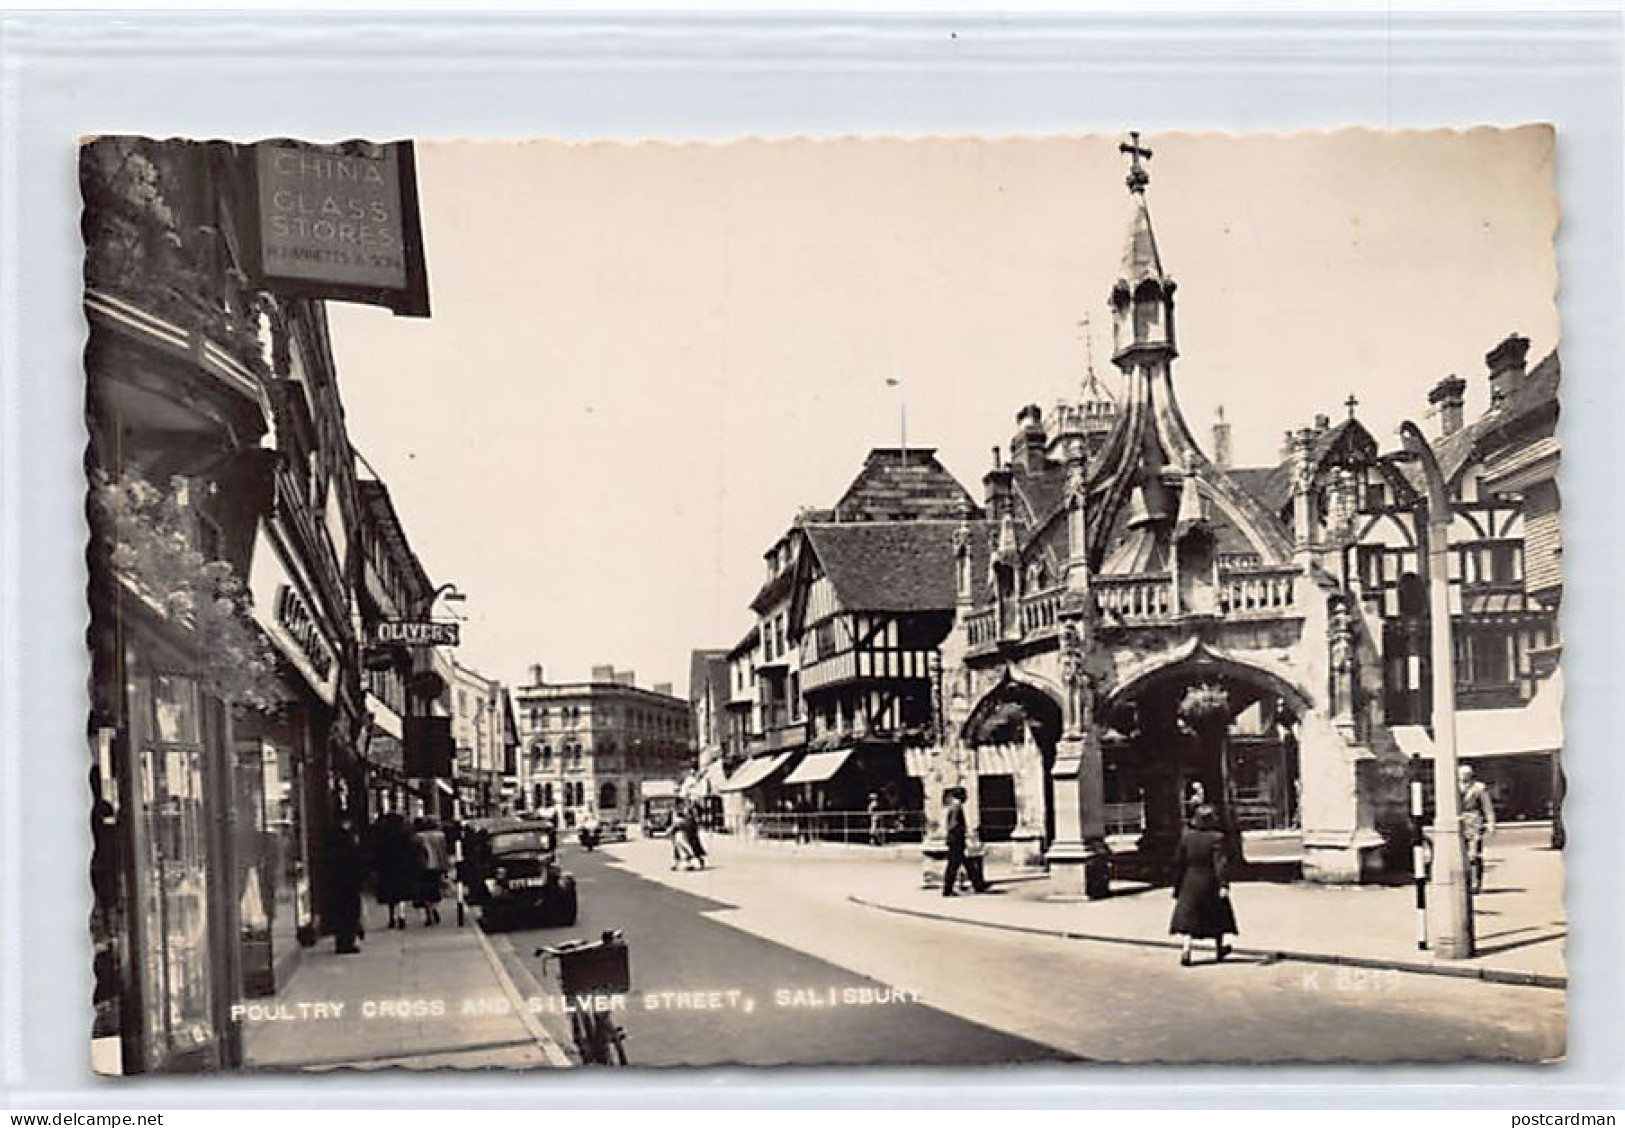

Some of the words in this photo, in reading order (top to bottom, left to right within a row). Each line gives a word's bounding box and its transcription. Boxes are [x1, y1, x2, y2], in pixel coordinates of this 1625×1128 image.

[274, 152, 385, 187] CHINA
[273, 190, 388, 222] GLASS
[269, 215, 395, 248] STORES
